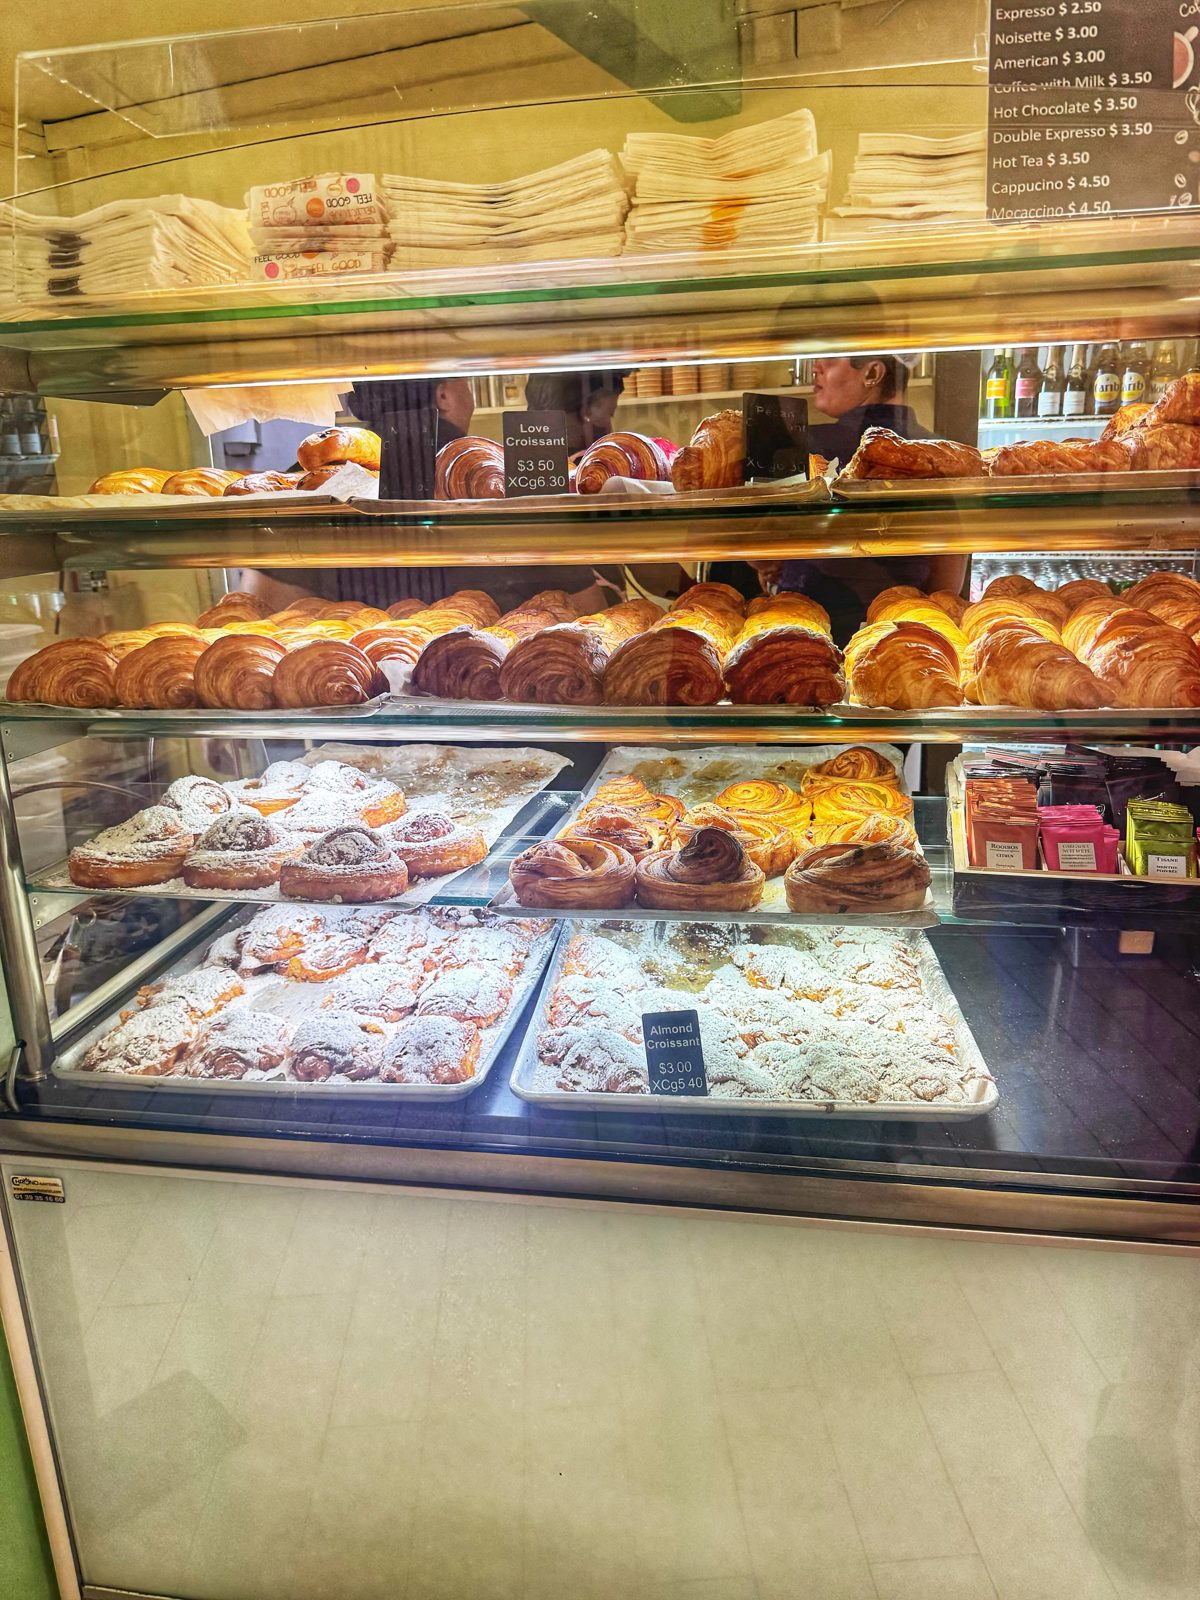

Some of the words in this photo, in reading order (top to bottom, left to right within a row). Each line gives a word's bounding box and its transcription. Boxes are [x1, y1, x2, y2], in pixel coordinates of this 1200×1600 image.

[995, 7, 1055, 21] Expresso
[1058, 2, 1068, 16] $
[1071, 1, 1102, 14] 2.50
[995, 30, 1051, 45] Noisette
[1055, 27, 1064, 42] $
[1067, 25, 1098, 39] 3.00
[994, 54, 1059, 70] American
[1062, 51, 1071, 66] $
[1074, 49, 1105, 63] 3.00
[994, 80, 1037, 94] Coffee
[1040, 77, 1071, 91] with
[1074, 75, 1105, 88] Milk
[1108, 72, 1117, 87] $
[1121, 71, 1152, 85] 3.50
[993, 106, 1018, 120] Hot
[1021, 101, 1090, 117] Chocolate
[1093, 97, 1103, 113] $
[1106, 96, 1137, 110] 3.50
[993, 129, 1042, 144] Double
[1046, 126, 1106, 142] Expresso
[1109, 122, 1118, 138] $
[1121, 122, 1152, 136] 3.50
[993, 156, 1017, 169] Hot
[1020, 155, 1043, 167] Tea
[1047, 152, 1056, 167] $
[1059, 151, 1090, 165] 3.50
[992, 178, 1064, 196] Cappucino
[1067, 176, 1076, 191] $
[1079, 175, 1110, 188] 4.50
[326, 196, 351, 208] GOOD
[353, 193, 373, 205] FEEL
[991, 204, 1064, 220] Mocaccino
[1068, 201, 1076, 218] $
[1079, 200, 1111, 215] 4.50
[254, 254, 273, 264] FEEL
[332, 258, 361, 271] GOOD
[520, 424, 550, 433] Love
[506, 437, 565, 446] Croissant
[517, 460, 555, 472] $350
[508, 475, 565, 490] XCg6.30
[650, 1023, 693, 1036] Almond
[647, 1037, 700, 1050] Croissant
[652, 1077, 703, 1093] XCg540
